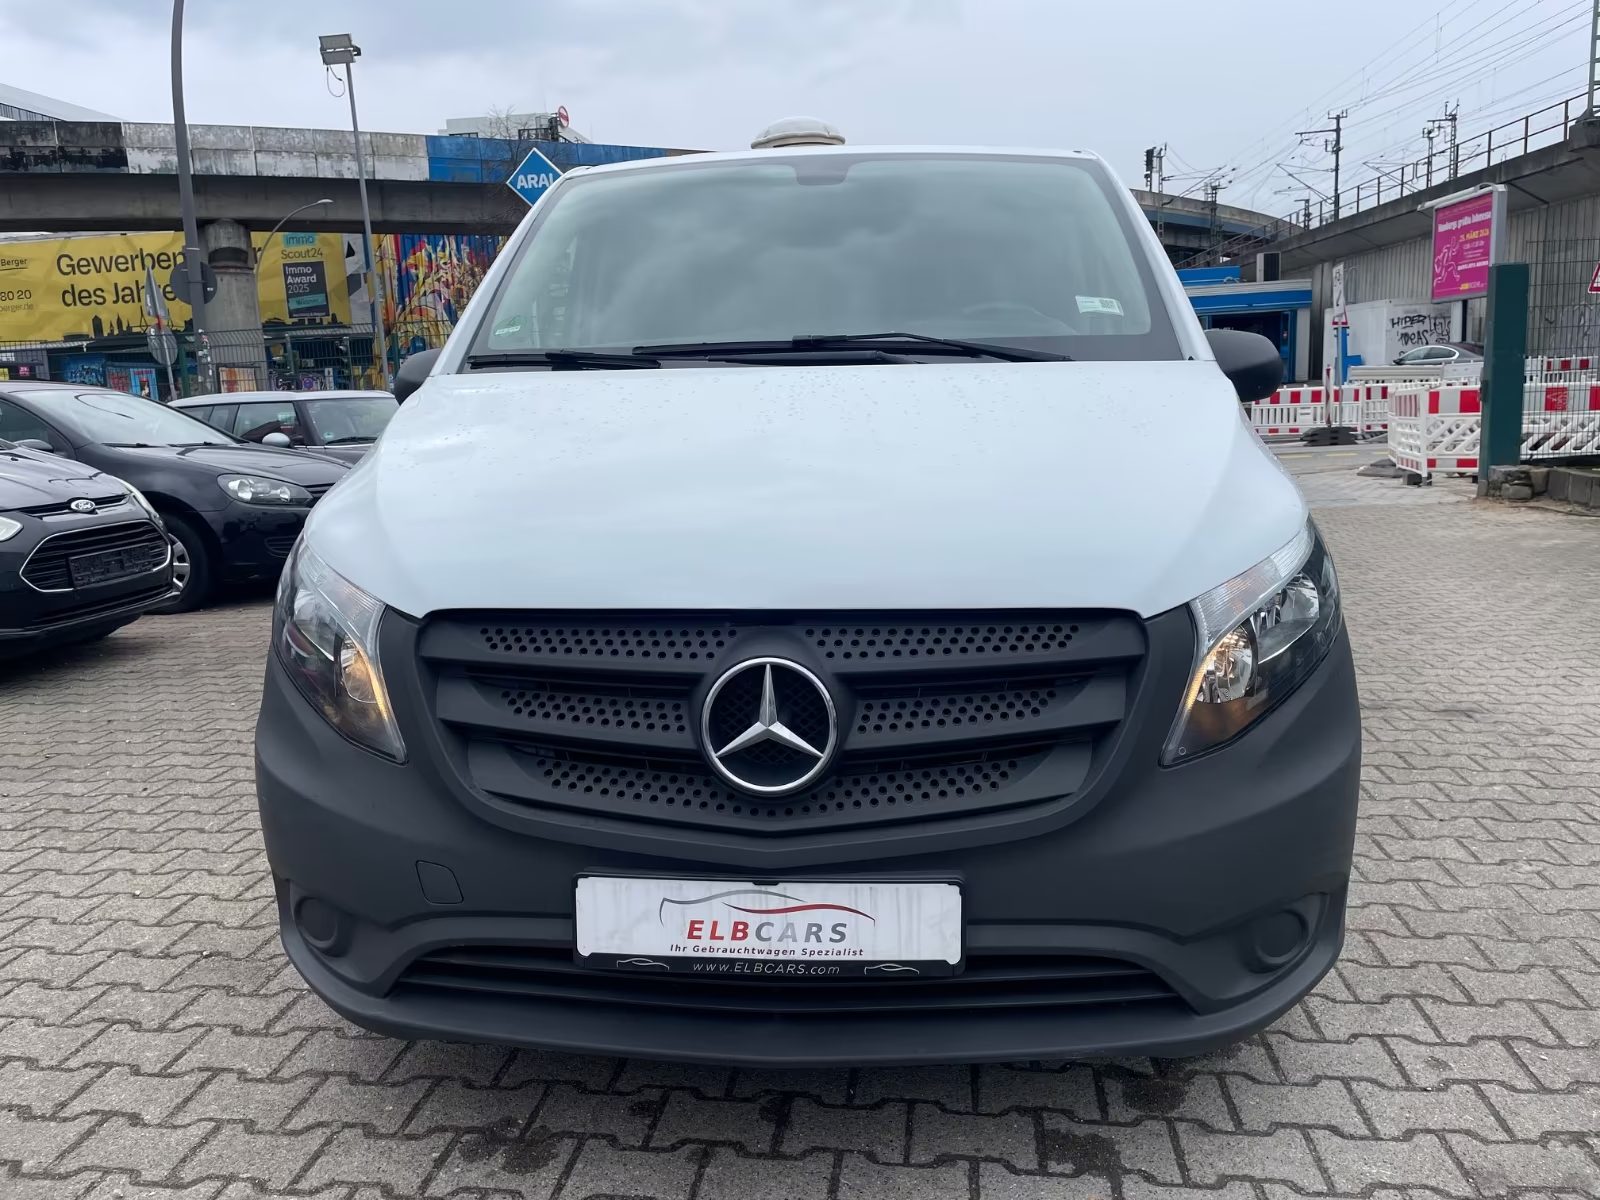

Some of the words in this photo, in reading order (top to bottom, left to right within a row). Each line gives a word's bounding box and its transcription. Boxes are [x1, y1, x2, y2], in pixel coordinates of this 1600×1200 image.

[281, 248, 323, 260] Scout24
[0, 257, 28, 268] Berger
[286, 265, 312, 275] Immo
[287, 274, 317, 284] Award
[16, 289, 32, 300] 20
[287, 284, 310, 294] 2025
[61, 283, 107, 307] des
[687, 920, 847, 943] ELBCARS
[670, 944, 687, 952] Ihr
[693, 945, 796, 957] Gebrauchtwagen
[801, 948, 864, 957] Spezialist
[693, 962, 840, 975] www.ELBCARS.com
